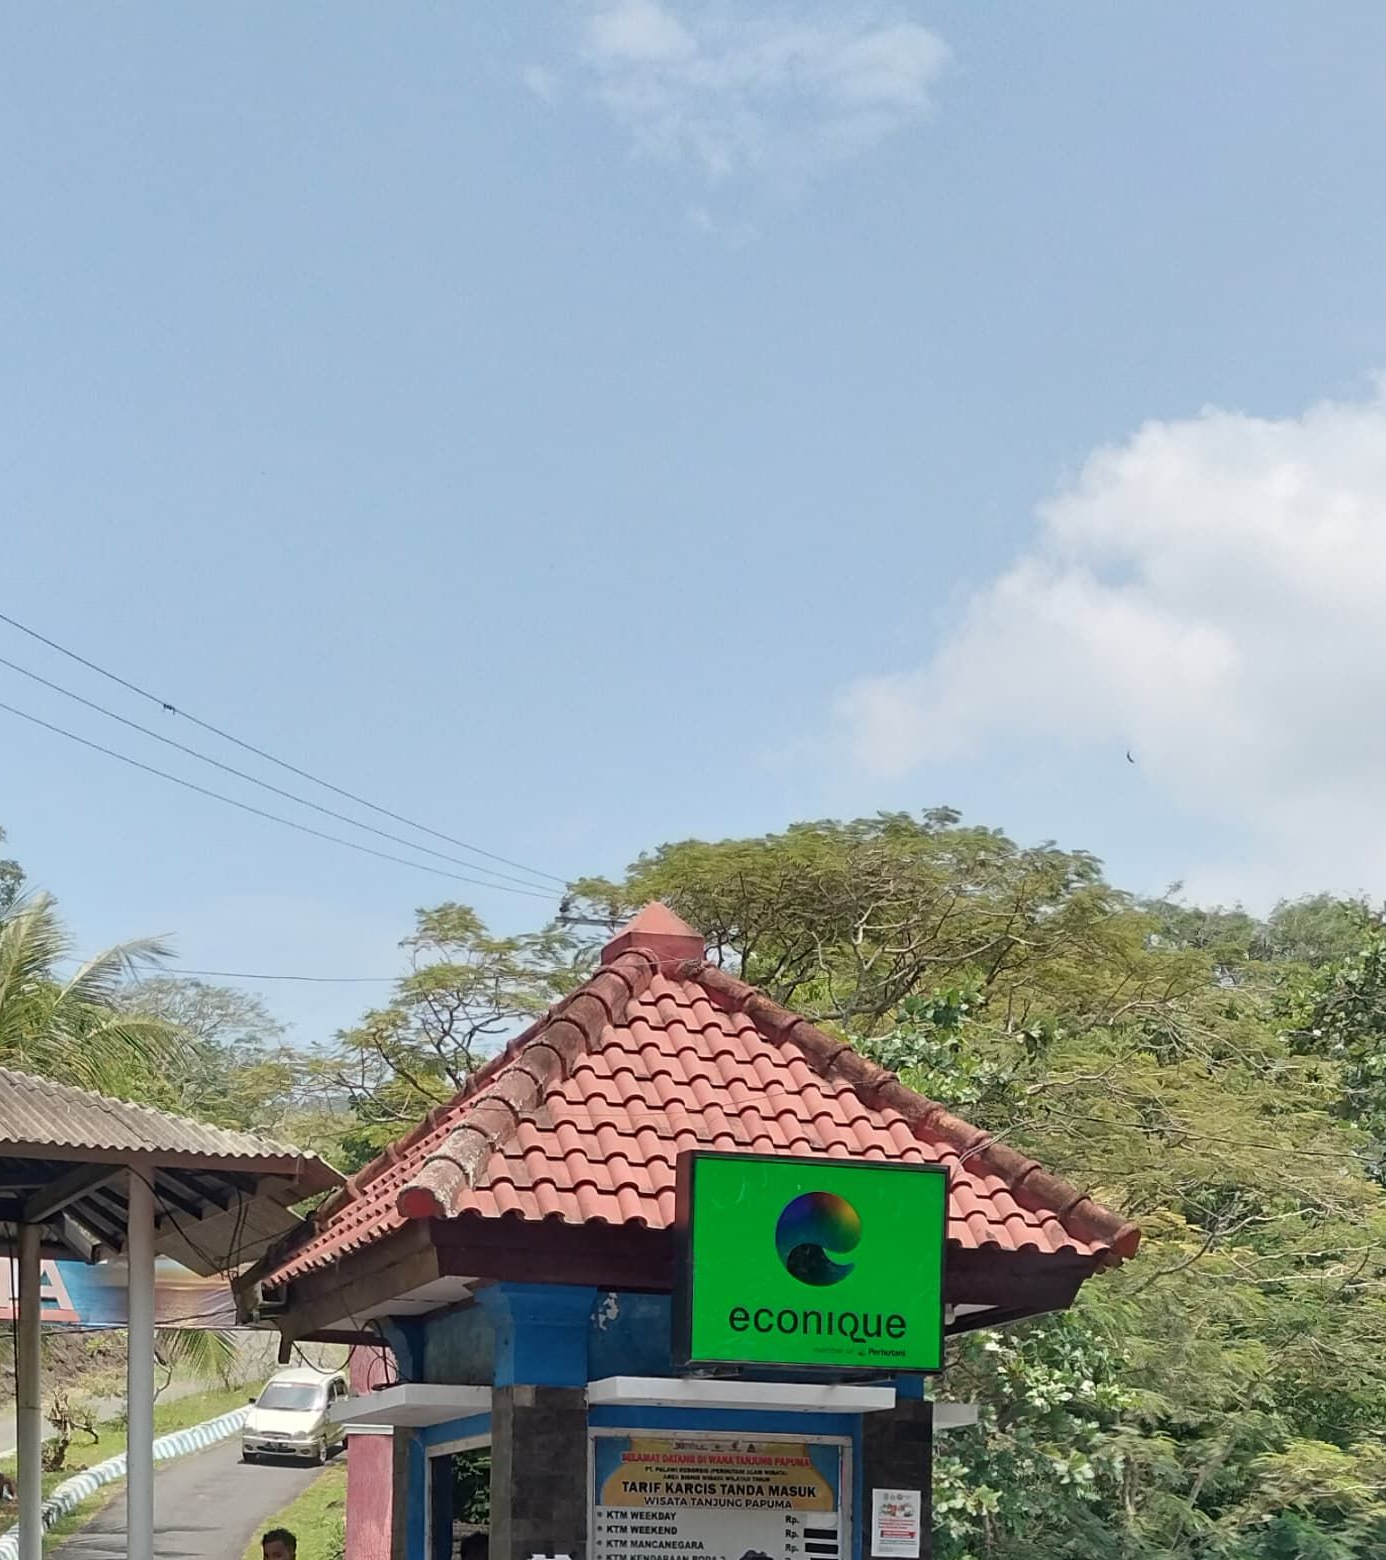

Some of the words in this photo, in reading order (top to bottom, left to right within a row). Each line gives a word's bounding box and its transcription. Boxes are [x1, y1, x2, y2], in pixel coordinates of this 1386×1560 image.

[728, 1306, 907, 1344] econique
[622, 1481, 662, 1493] TARIF
[665, 1482, 716, 1495] KARCIS
[720, 1483, 764, 1496] TANDA
[768, 1484, 816, 1498] MASUK
[644, 1496, 688, 1506] WISATA
[691, 1497, 742, 1508] TANJUNG
[744, 1498, 792, 1509] PAPUMA
[606, 1511, 628, 1520] KTM
[630, 1511, 676, 1521] WEEKDAY
[785, 1515, 800, 1525] Rp.
[606, 1525, 628, 1534] KTM
[630, 1526, 678, 1535] WEEKEND
[785, 1529, 800, 1539] Rp.
[606, 1539, 628, 1548] KTM
[630, 1540, 704, 1550] MANCANEGARA
[785, 1543, 800, 1553] Rp.
